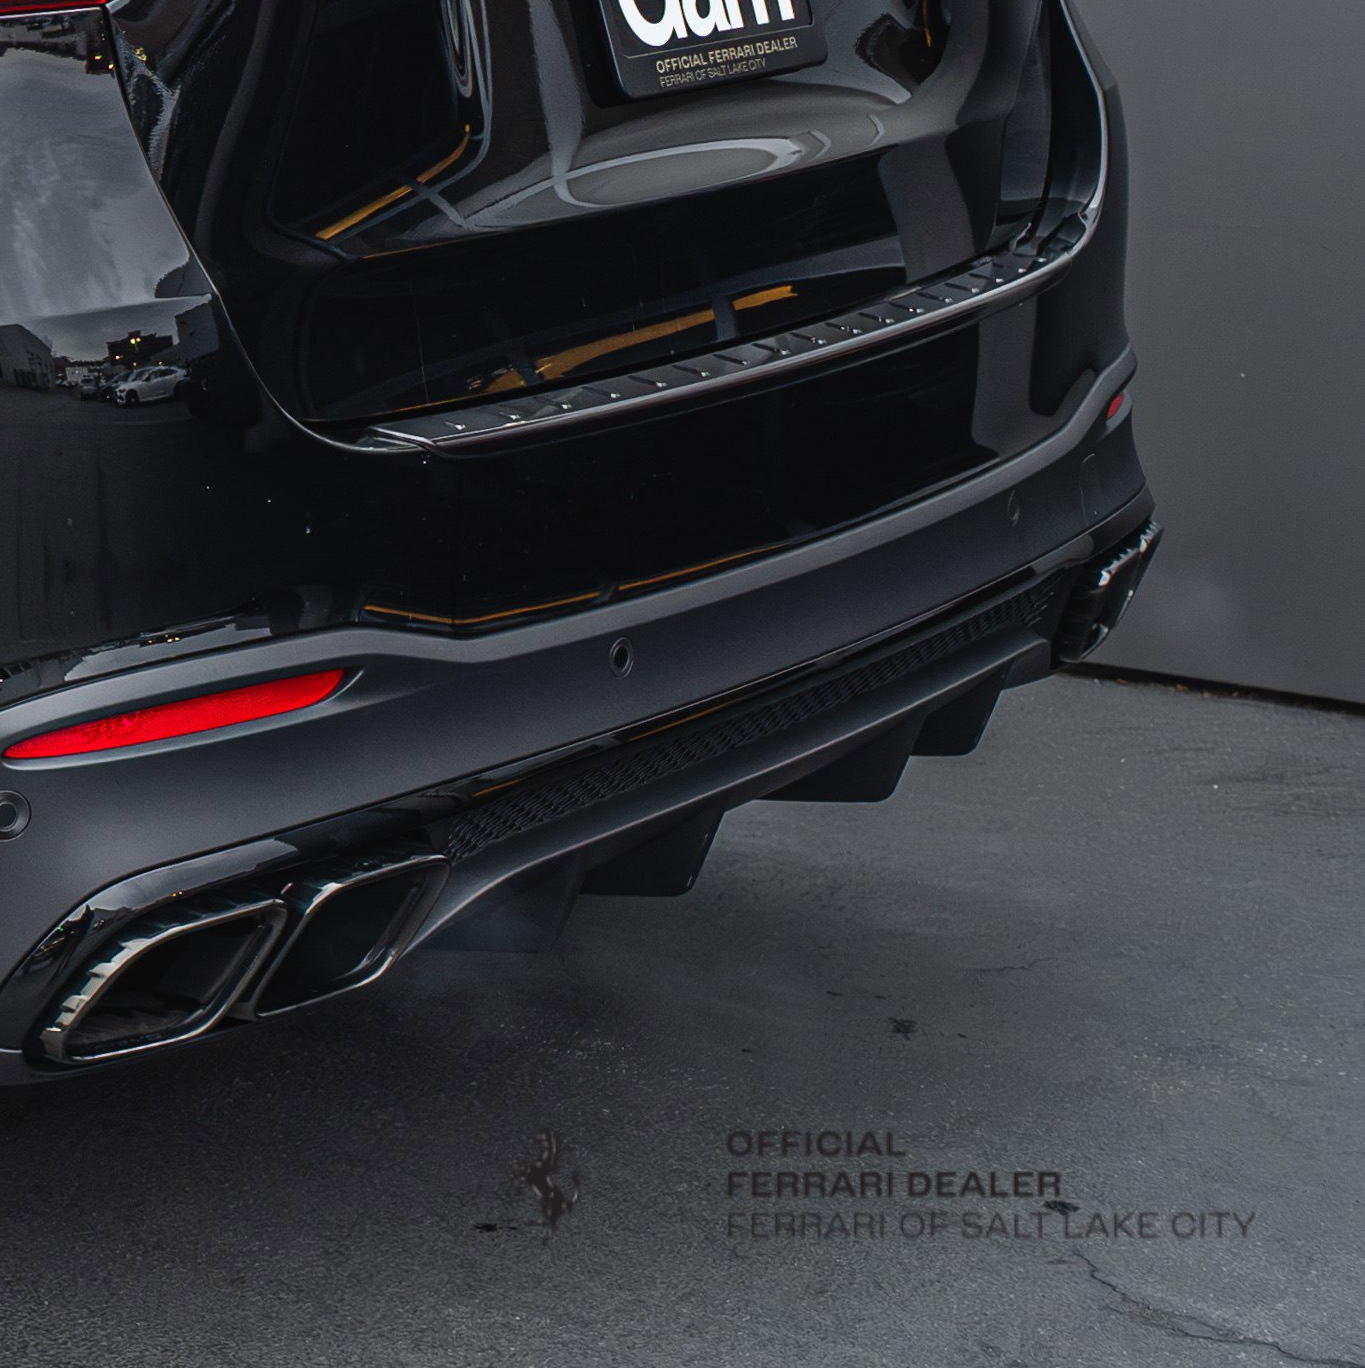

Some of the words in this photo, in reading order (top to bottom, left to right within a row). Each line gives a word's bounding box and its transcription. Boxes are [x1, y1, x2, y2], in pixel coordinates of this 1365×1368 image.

[656, 52, 708, 73] OFFICIAL
[708, 44, 756, 64] FERRARI
[755, 36, 798, 55] DEALER
[659, 72, 695, 88] FERRARI
[694, 69, 707, 81] OF
[707, 64, 726, 79] SALT
[726, 60, 749, 75] LAKE
[748, 57, 767, 72] CITY
